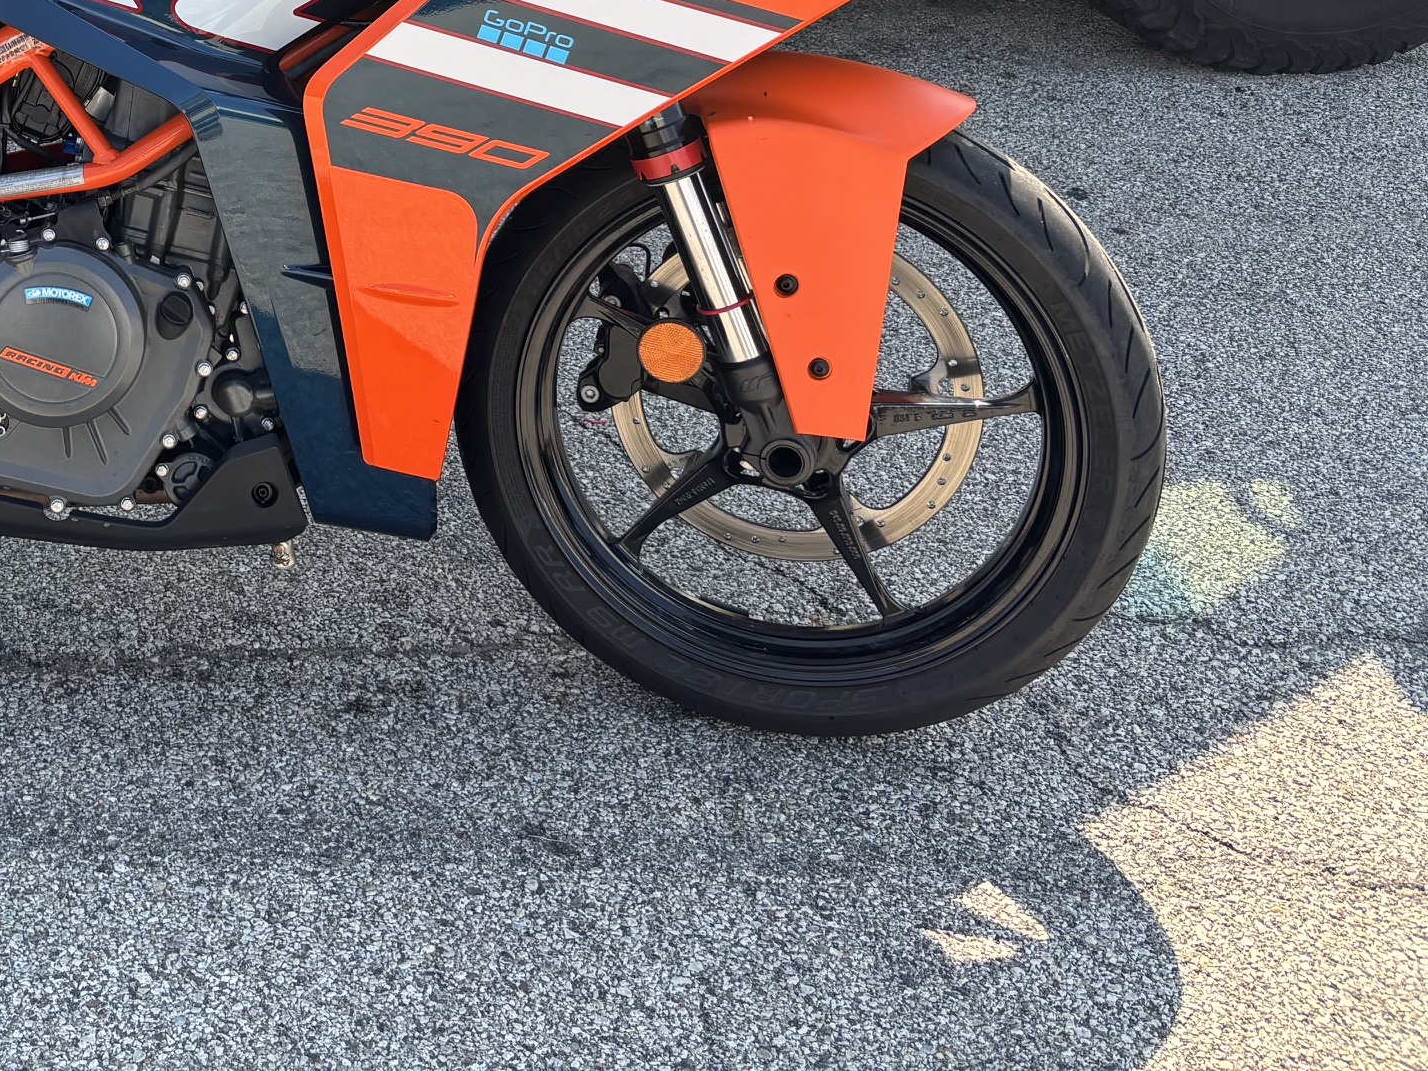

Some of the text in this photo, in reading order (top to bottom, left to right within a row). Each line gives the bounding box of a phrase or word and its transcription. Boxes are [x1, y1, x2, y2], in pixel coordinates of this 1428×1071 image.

[483, 9, 574, 48] GoPro
[340, 106, 550, 169] 390
[42, 288, 88, 304] MOTOREX
[5, 351, 99, 389] RACING KTM
